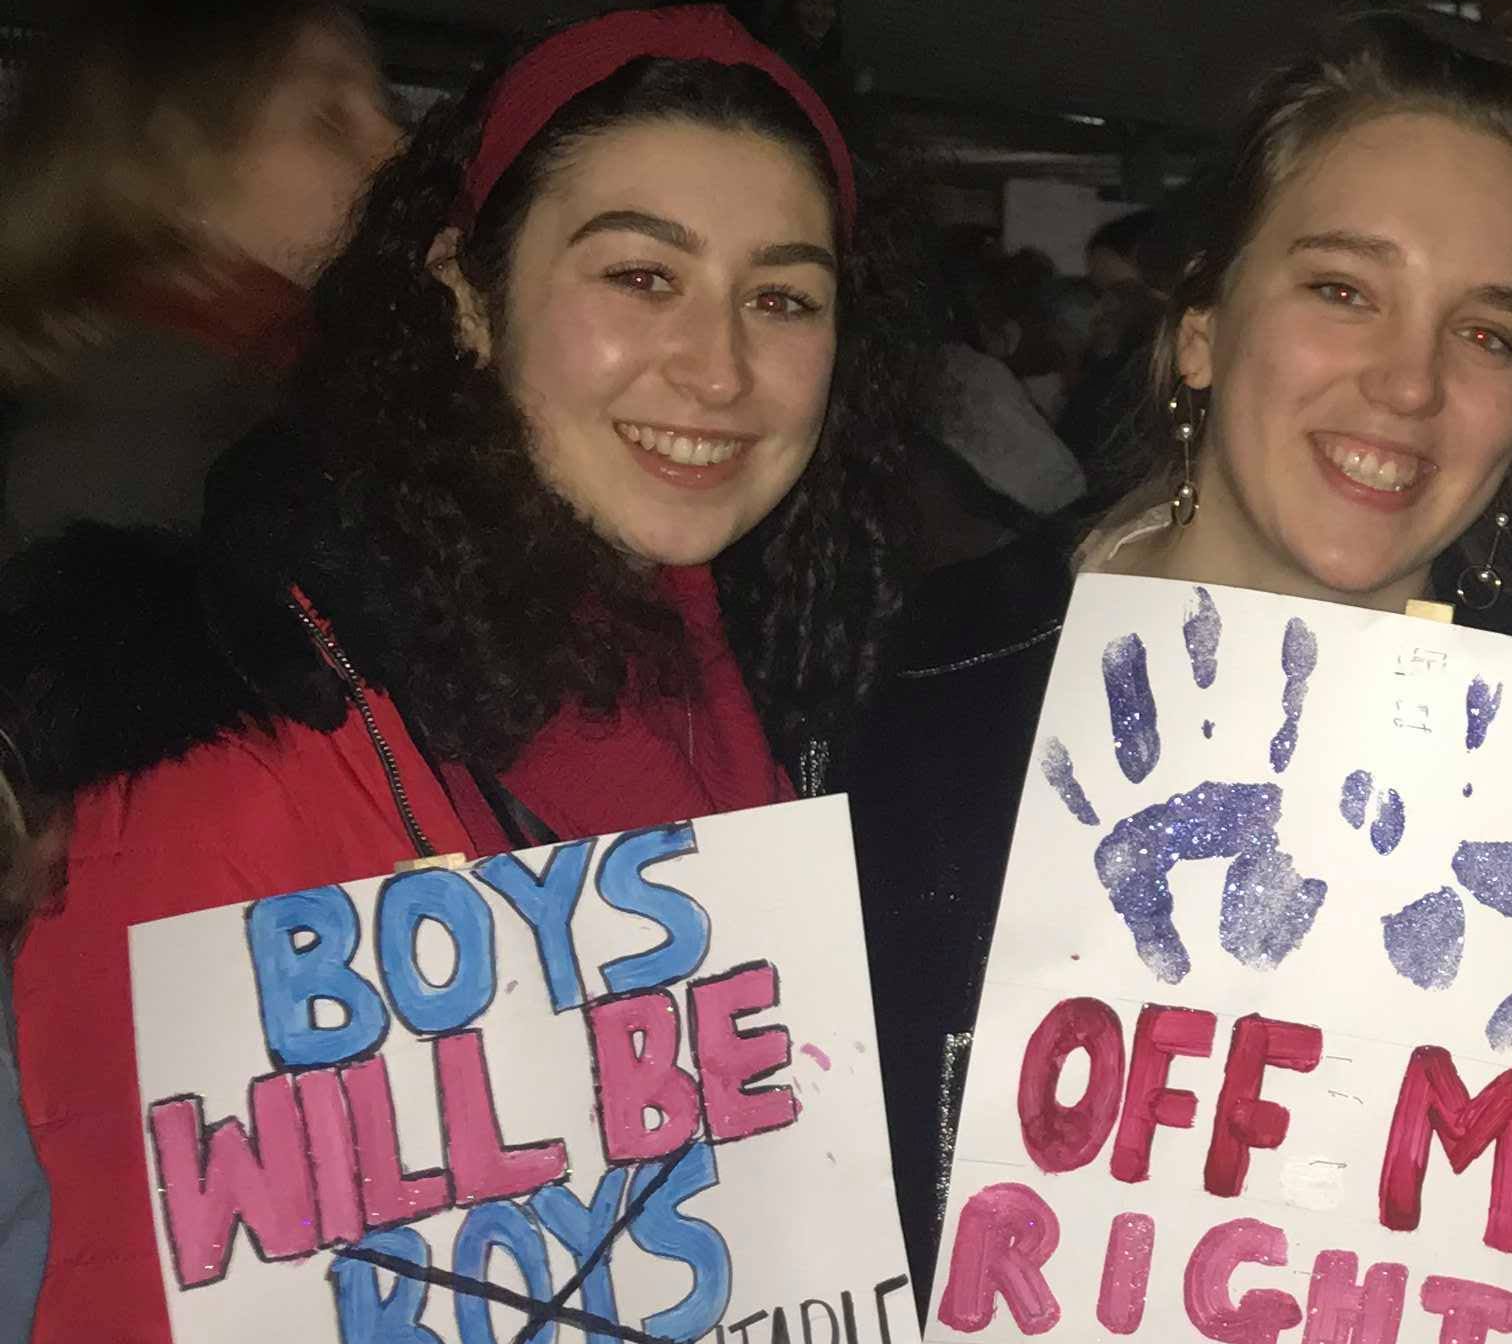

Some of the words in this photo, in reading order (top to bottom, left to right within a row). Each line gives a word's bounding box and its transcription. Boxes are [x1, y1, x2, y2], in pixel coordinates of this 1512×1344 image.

[246, 821, 711, 1070] BOYS
[149, 1029, 569, 1289] WILL
[587, 961, 802, 1166] BE
[1017, 997, 1323, 1197] OFF
